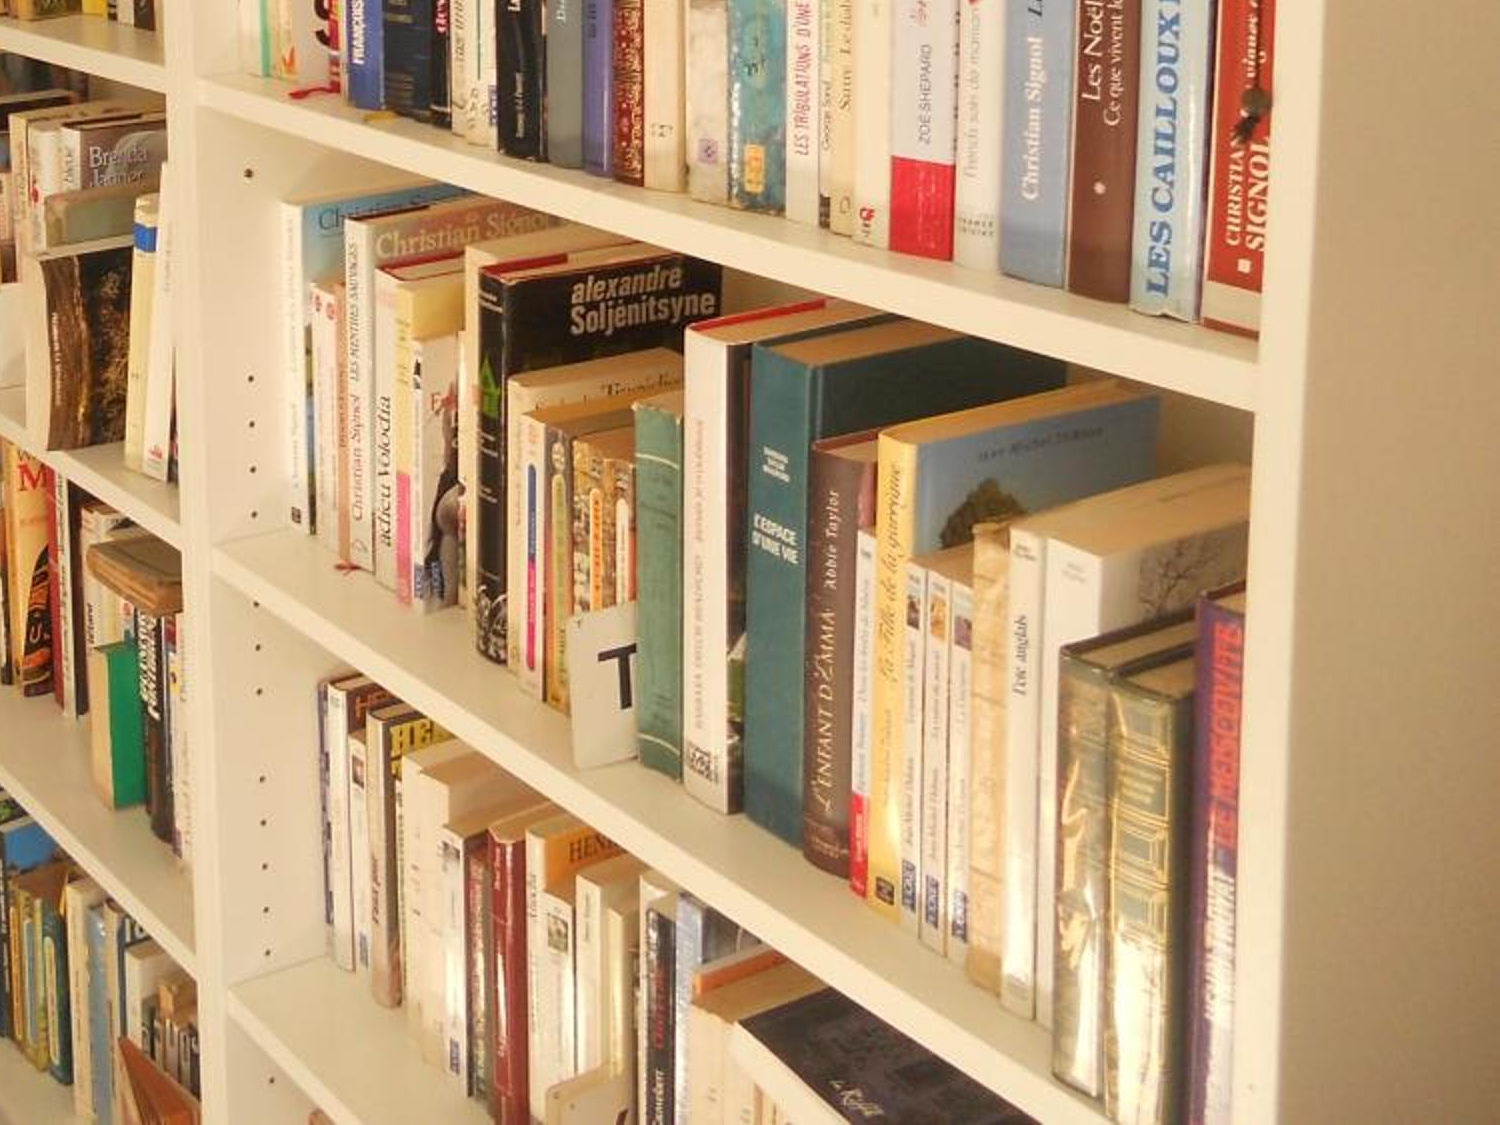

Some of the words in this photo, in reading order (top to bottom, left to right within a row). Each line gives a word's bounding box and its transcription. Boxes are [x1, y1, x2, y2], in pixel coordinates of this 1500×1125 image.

[794, 0, 811, 39] D'UNE
[1106, 14, 1123, 69] vivent
[794, 43, 811, 130] TRIBULATIONS
[917, 44, 933, 113] SHEPARD
[1026, 36, 1049, 106] Signol
[1081, 68, 1102, 104] Les
[1106, 69, 1126, 103] que
[1104, 103, 1121, 127] Ce
[1151, 11, 1181, 214] CAILLOUX
[794, 135, 809, 156] LES
[1021, 107, 1043, 201] Christian
[1244, 135, 1270, 253] SIGNOL
[374, 221, 481, 260] Christian
[1145, 220, 1173, 298] LES
[571, 264, 683, 304] alexandre
[570, 291, 716, 336] Soljénitsyne
[349, 393, 364, 444] Signol
[376, 395, 392, 478] Volodia
[350, 447, 365, 523] Christian
[379, 483, 393, 548] adieu
[752, 513, 800, 546] L'ESPACE
[824, 488, 840, 539] Taylor
[782, 545, 800, 565] VIE
[822, 544, 839, 590] Abbie
[1014, 613, 1031, 663] anglais
[597, 643, 637, 710] T
[1210, 620, 1244, 804] MOSCOVITE
[810, 706, 836, 813] L'ENFANT
